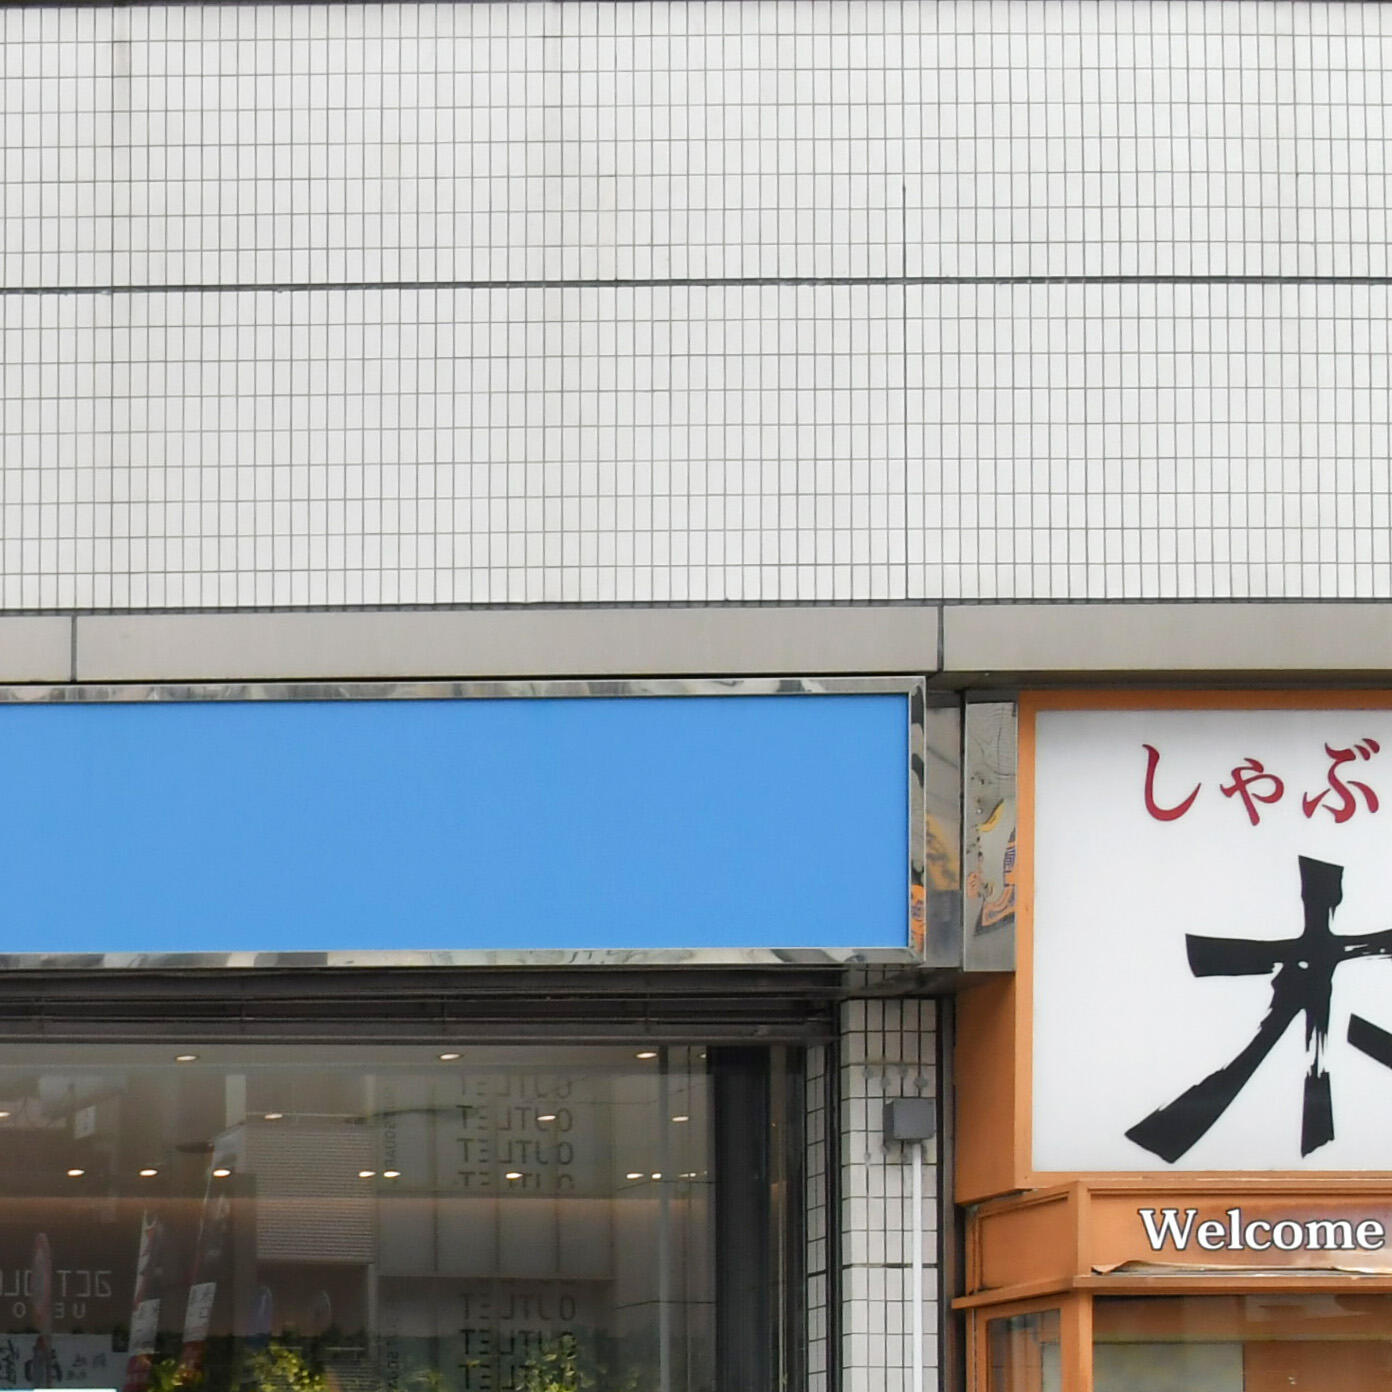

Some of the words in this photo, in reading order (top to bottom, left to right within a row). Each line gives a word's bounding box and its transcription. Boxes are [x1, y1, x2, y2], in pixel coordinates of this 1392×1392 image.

[1142, 737, 1381, 827] しゃぶ
[1138, 1208, 1385, 1251] Welcome
